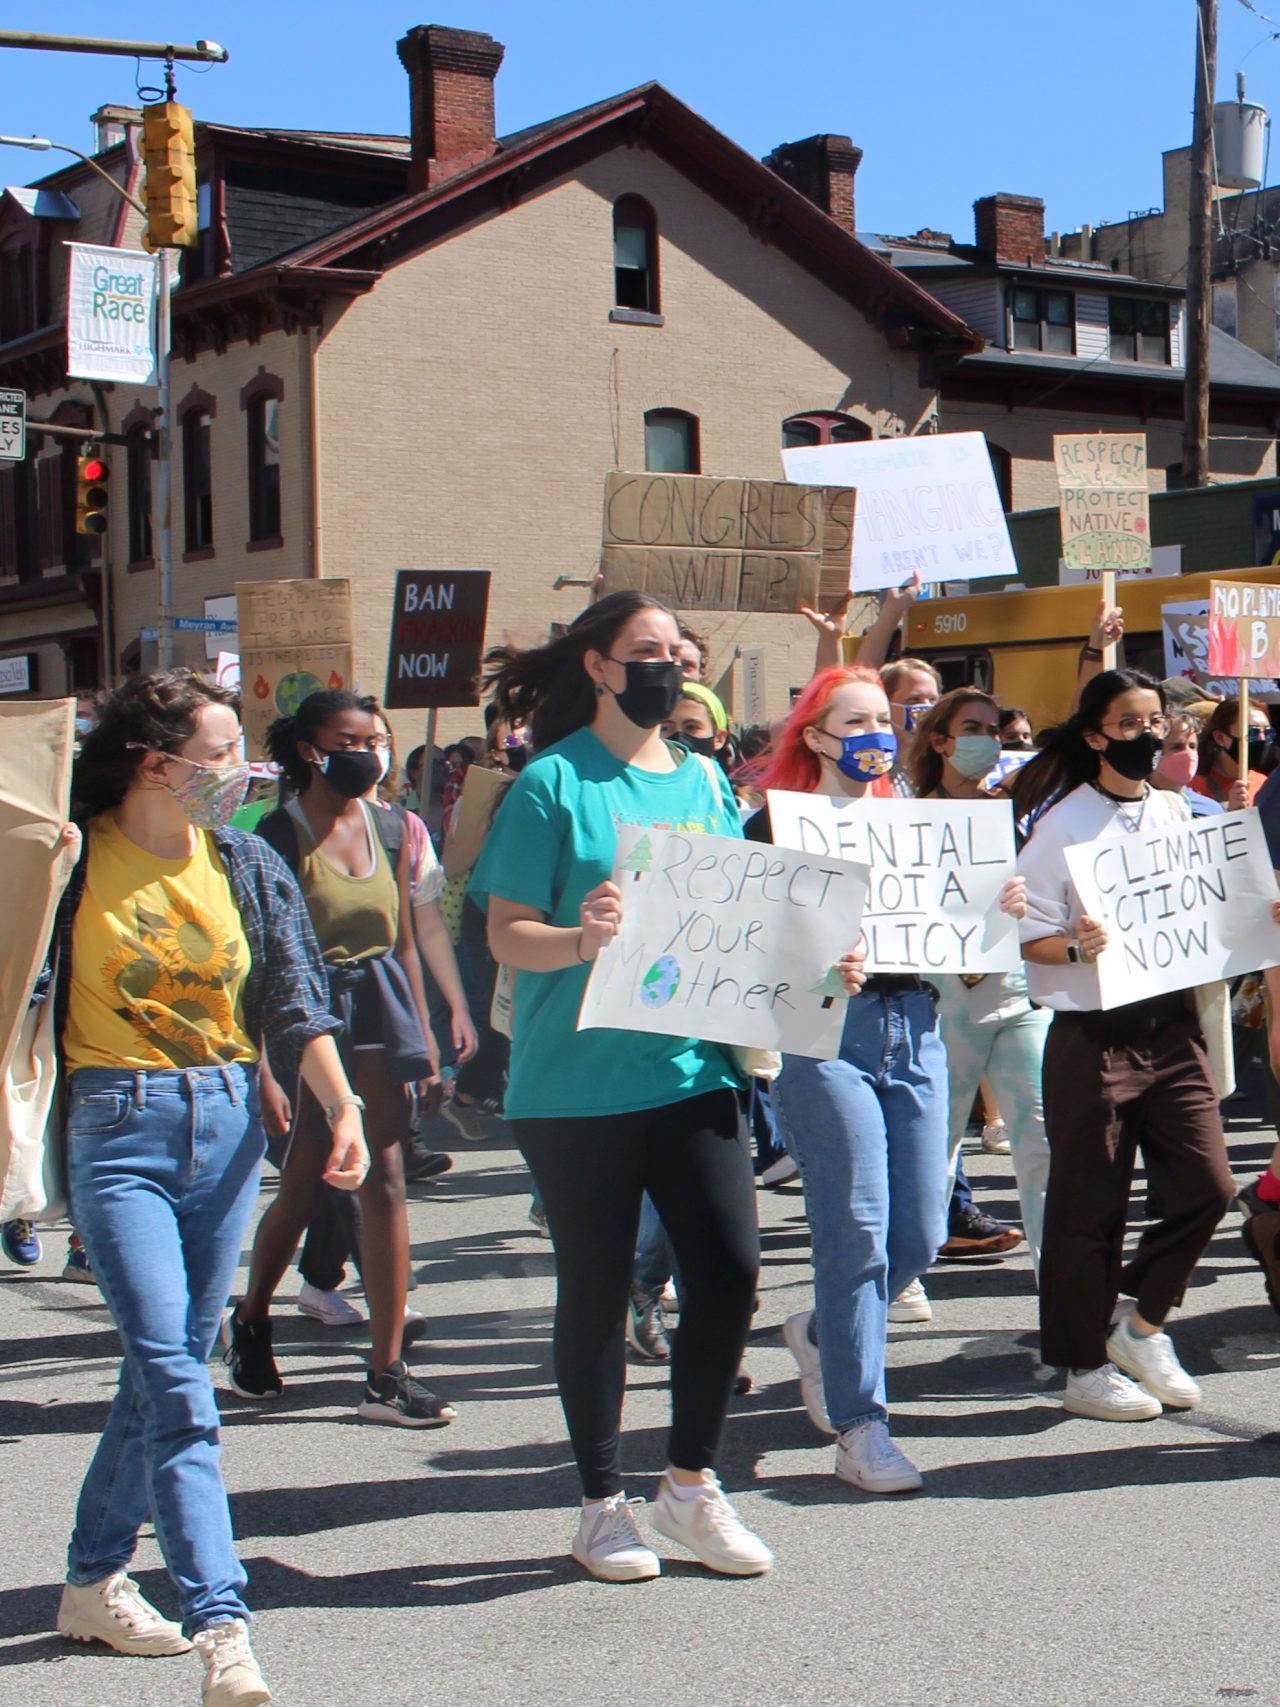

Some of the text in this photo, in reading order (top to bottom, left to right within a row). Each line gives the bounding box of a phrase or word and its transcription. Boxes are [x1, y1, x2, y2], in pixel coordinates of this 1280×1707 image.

[92, 265, 145, 297] Great
[93, 291, 145, 324] Race
[1060, 439, 1144, 467] RESPECT
[608, 478, 853, 551] CONGRESS
[855, 480, 1003, 542] HANGING
[1064, 488, 1148, 512] PROTECT
[1069, 512, 1133, 533] NATIVE
[1079, 538, 1144, 566] LAND
[669, 553, 792, 604] WTF?
[404, 583, 455, 612] BAN
[1214, 586, 1240, 618] NO
[178, 618, 217, 633] Meyran
[935, 612, 967, 633] 5910
[1250, 620, 1269, 660] B
[398, 652, 449, 679] NOW
[799, 816, 1008, 868] DENIAL
[1093, 820, 1249, 895] CLIMATE
[864, 870, 968, 912] OT A
[860, 922, 978, 968] LICY
[1122, 921, 1209, 975] NOW
